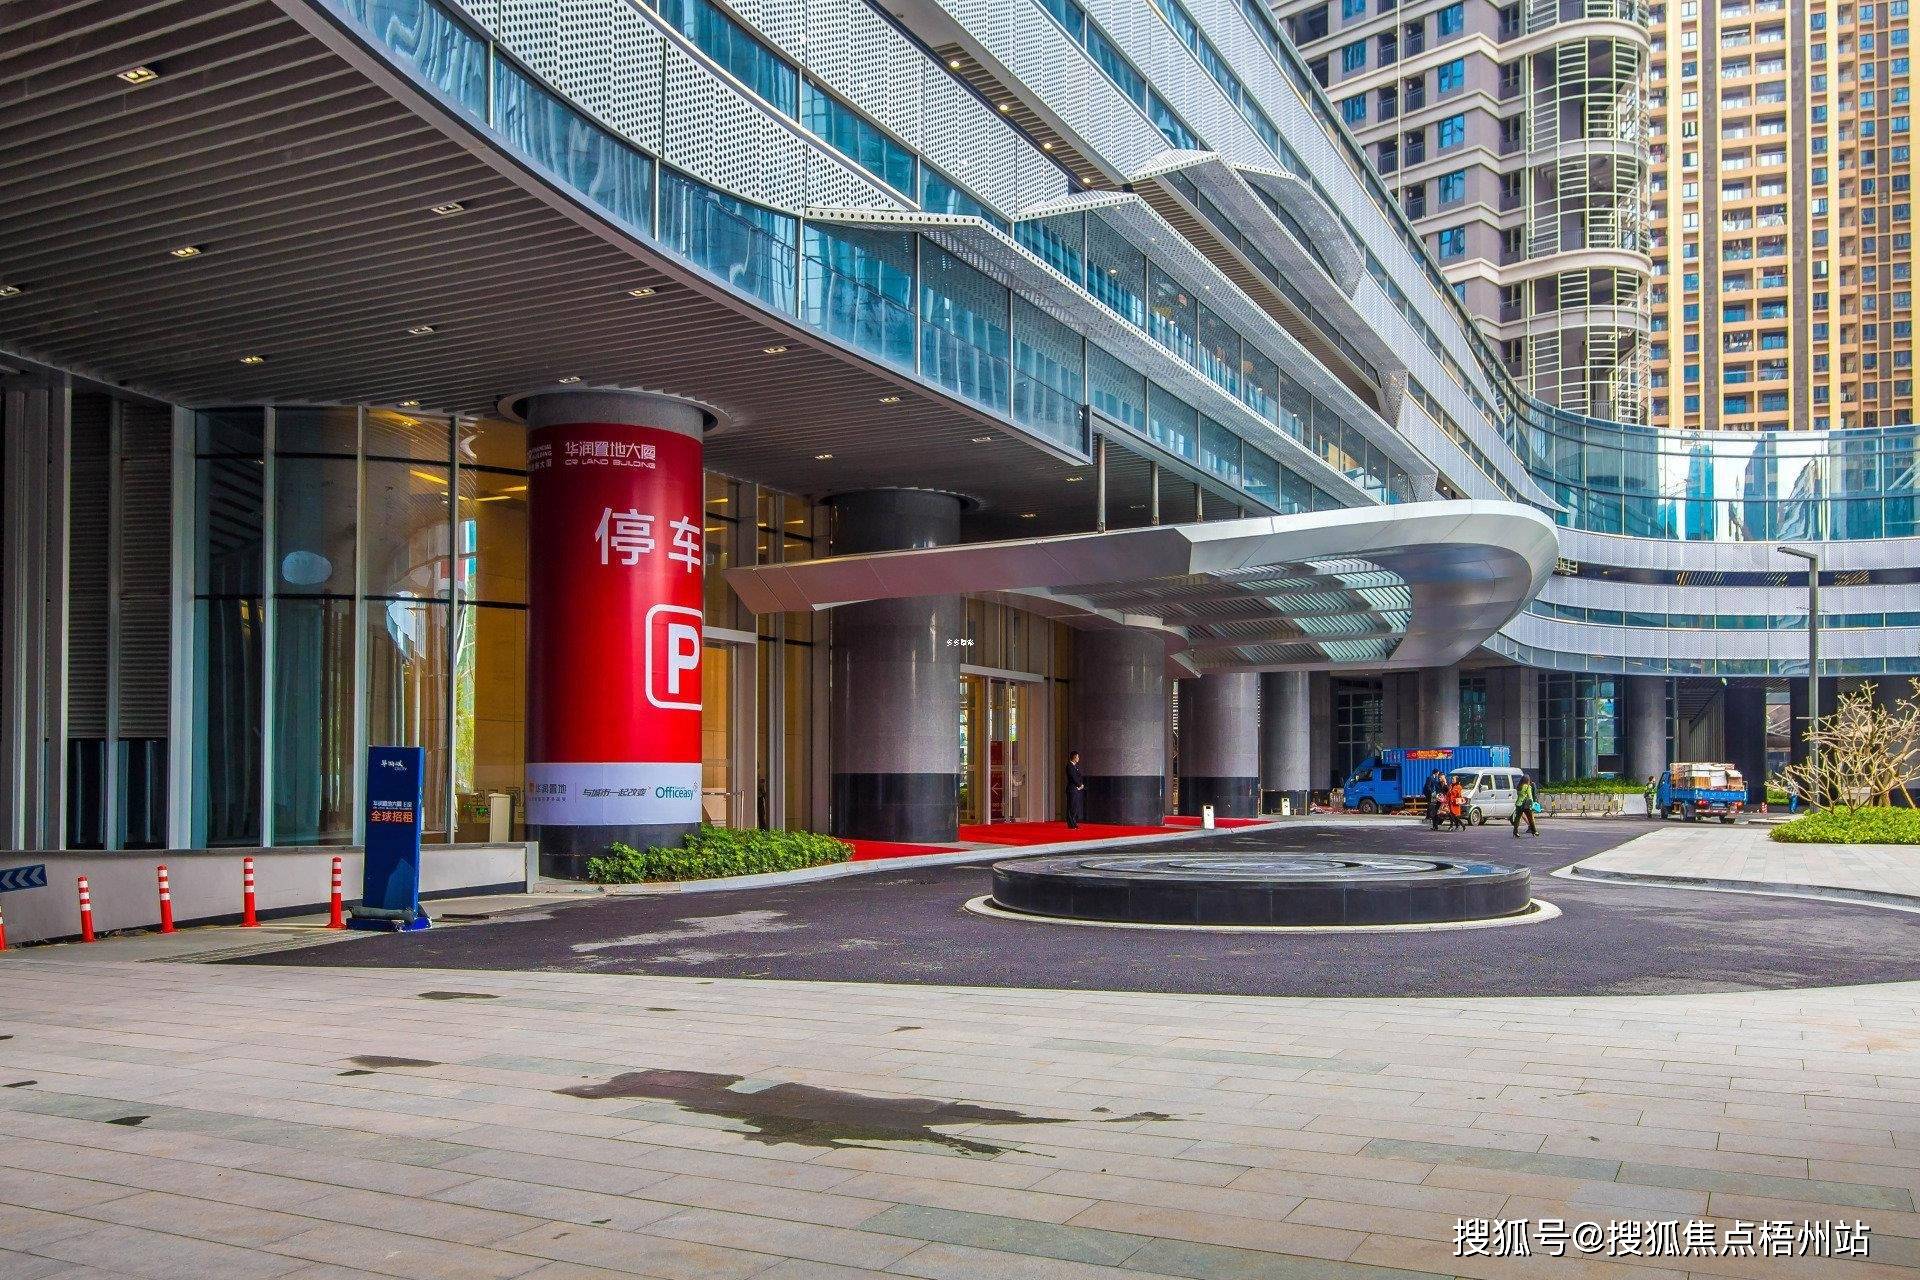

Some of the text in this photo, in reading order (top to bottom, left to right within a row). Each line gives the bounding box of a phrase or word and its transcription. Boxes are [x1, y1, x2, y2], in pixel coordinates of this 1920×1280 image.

[564, 441, 656, 460] 华润置地大厦
[612, 459, 656, 469] BUILDING
[595, 507, 701, 573] 停车
[667, 623, 700, 694] P
[582, 788, 647, 798] 与城市一起改变
[655, 786, 694, 800] Officeasy
[371, 810, 413, 823] 全球招租
